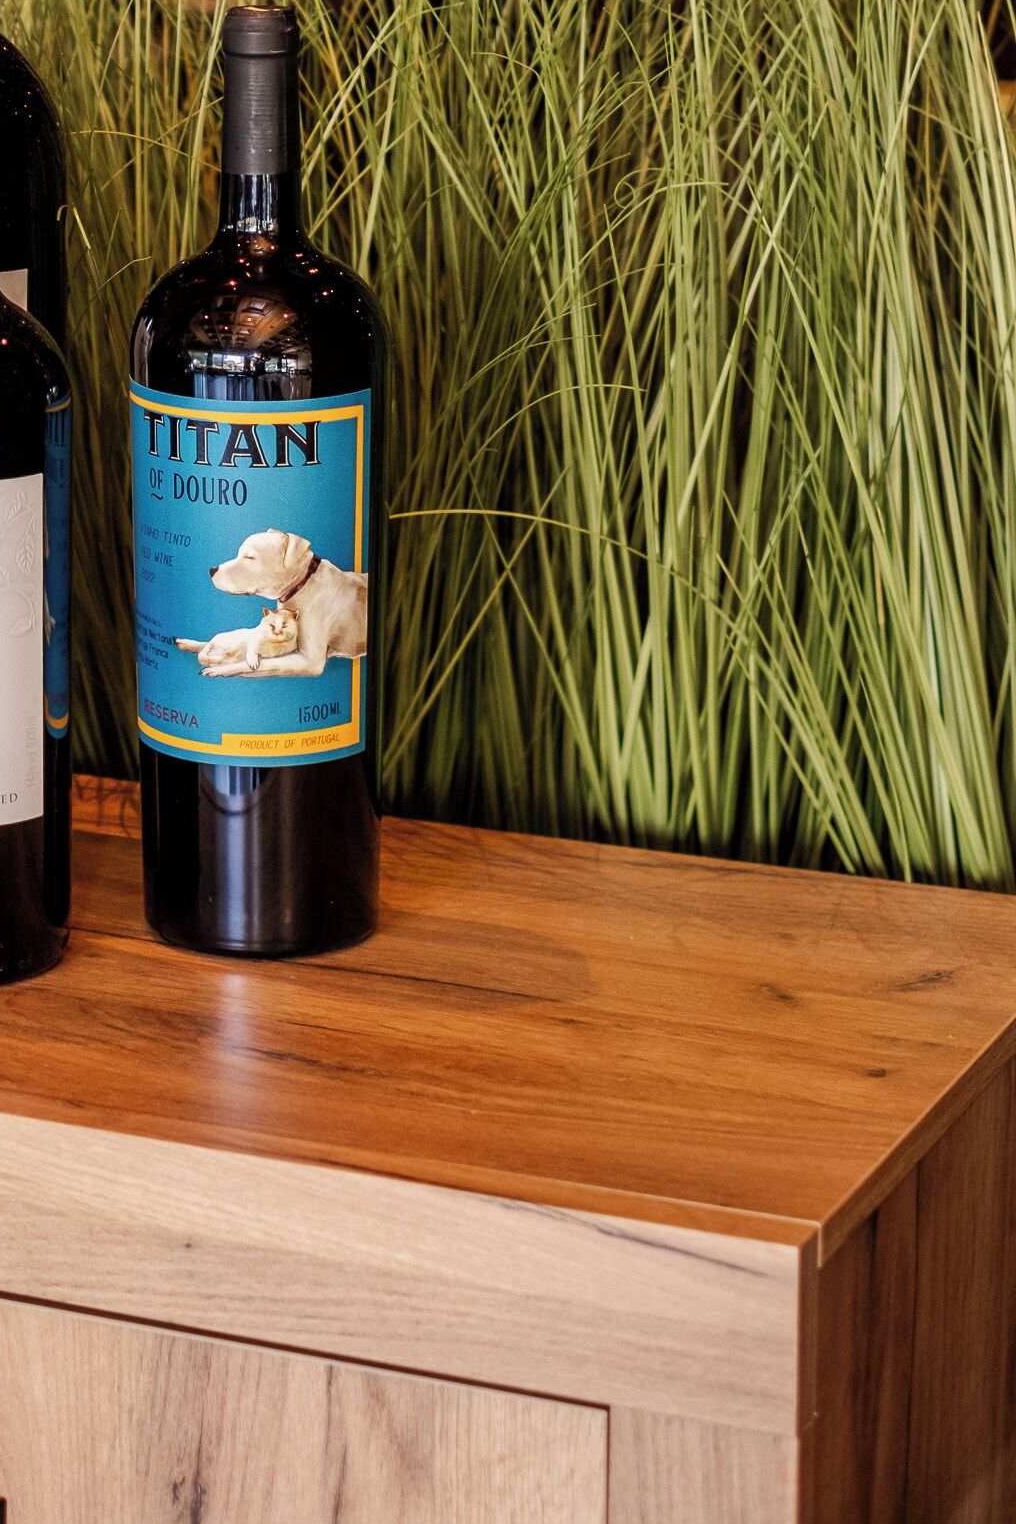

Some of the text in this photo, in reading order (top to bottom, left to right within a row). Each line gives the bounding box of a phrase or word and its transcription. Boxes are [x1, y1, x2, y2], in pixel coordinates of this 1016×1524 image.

[144, 408, 321, 468] TITAN
[149, 467, 247, 506] OF DOURO
[164, 531, 191, 547] TINTO
[154, 551, 174, 567] WINE
[144, 699, 199, 728] RESERVA
[239, 733, 340, 750] PRODUCT OF PORTUGAL
